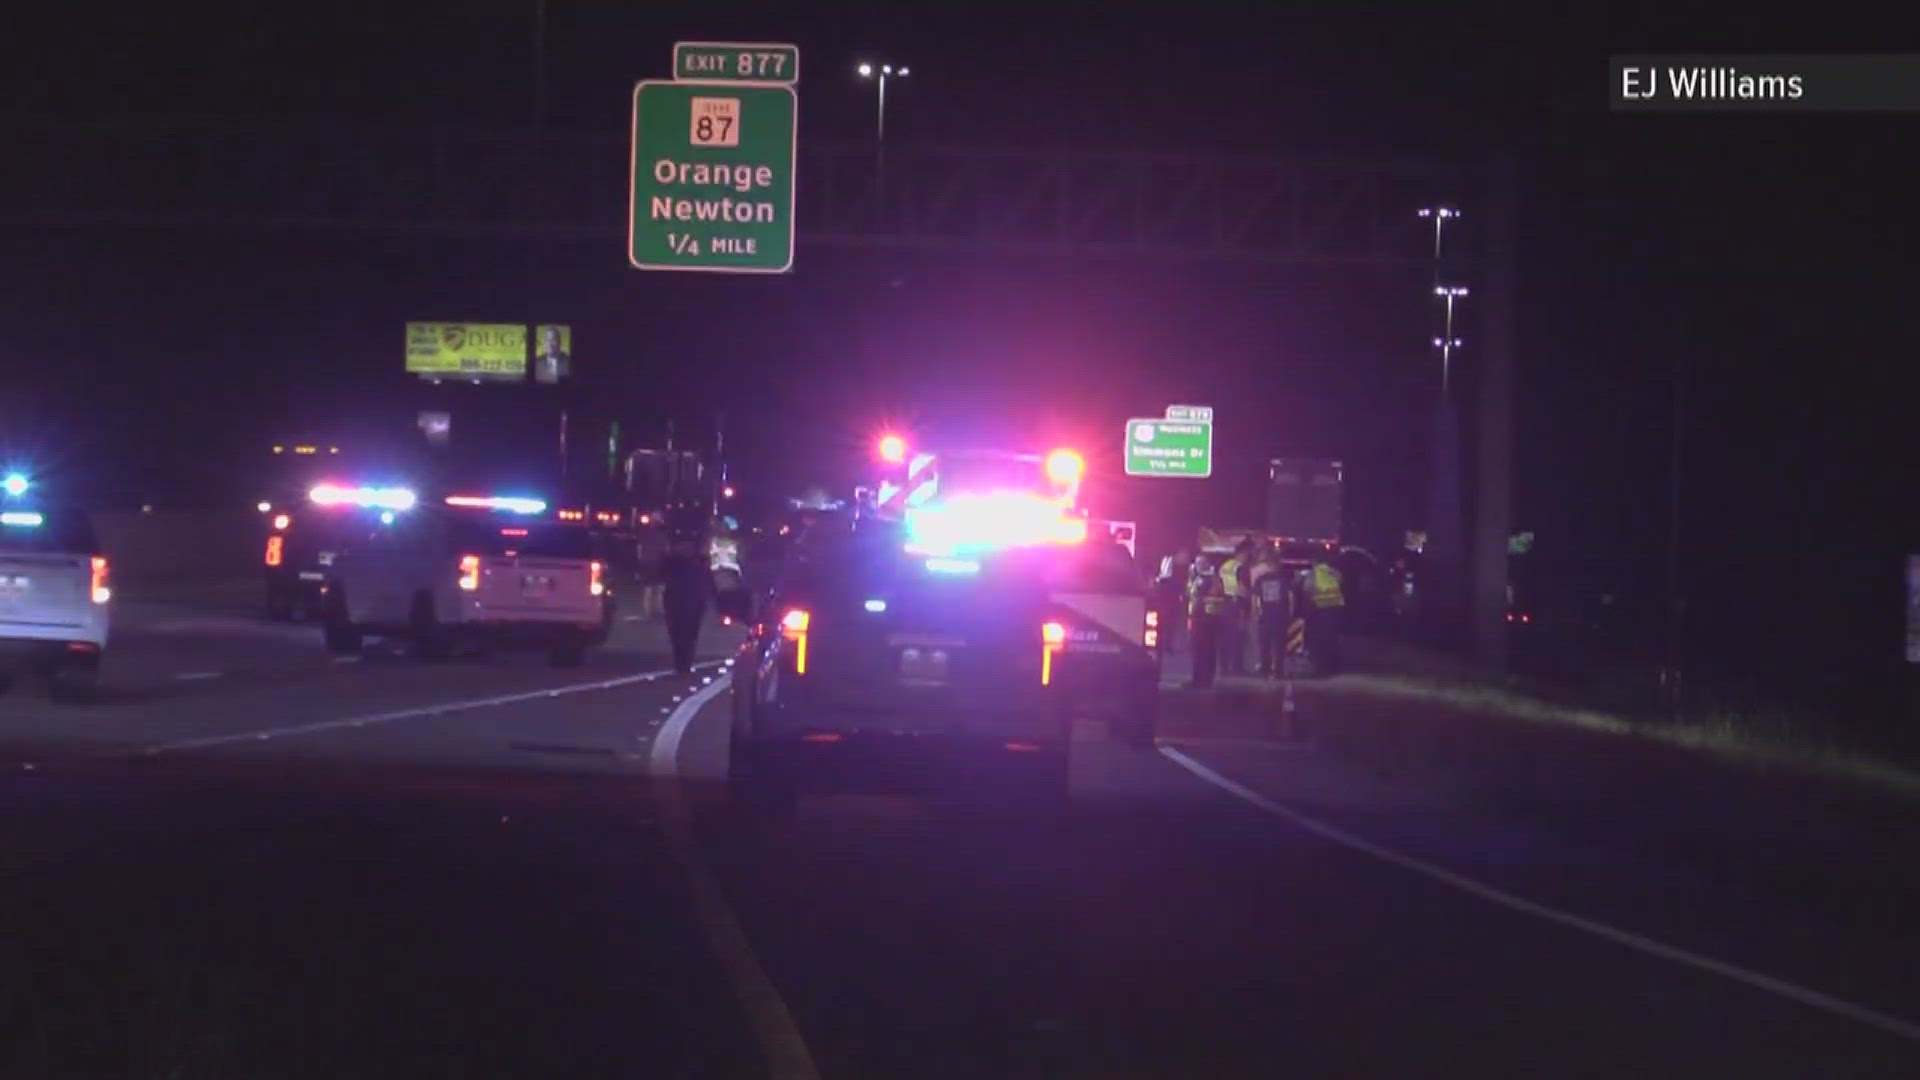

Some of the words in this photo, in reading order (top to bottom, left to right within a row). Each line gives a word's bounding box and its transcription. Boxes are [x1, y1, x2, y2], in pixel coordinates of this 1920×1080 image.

[685, 54, 727, 72] EXIT
[737, 52, 786, 76] 877
[696, 116, 733, 142] 87
[654, 159, 773, 192] Orange
[652, 196, 774, 223] Newton
[711, 237, 757, 254] MILE
